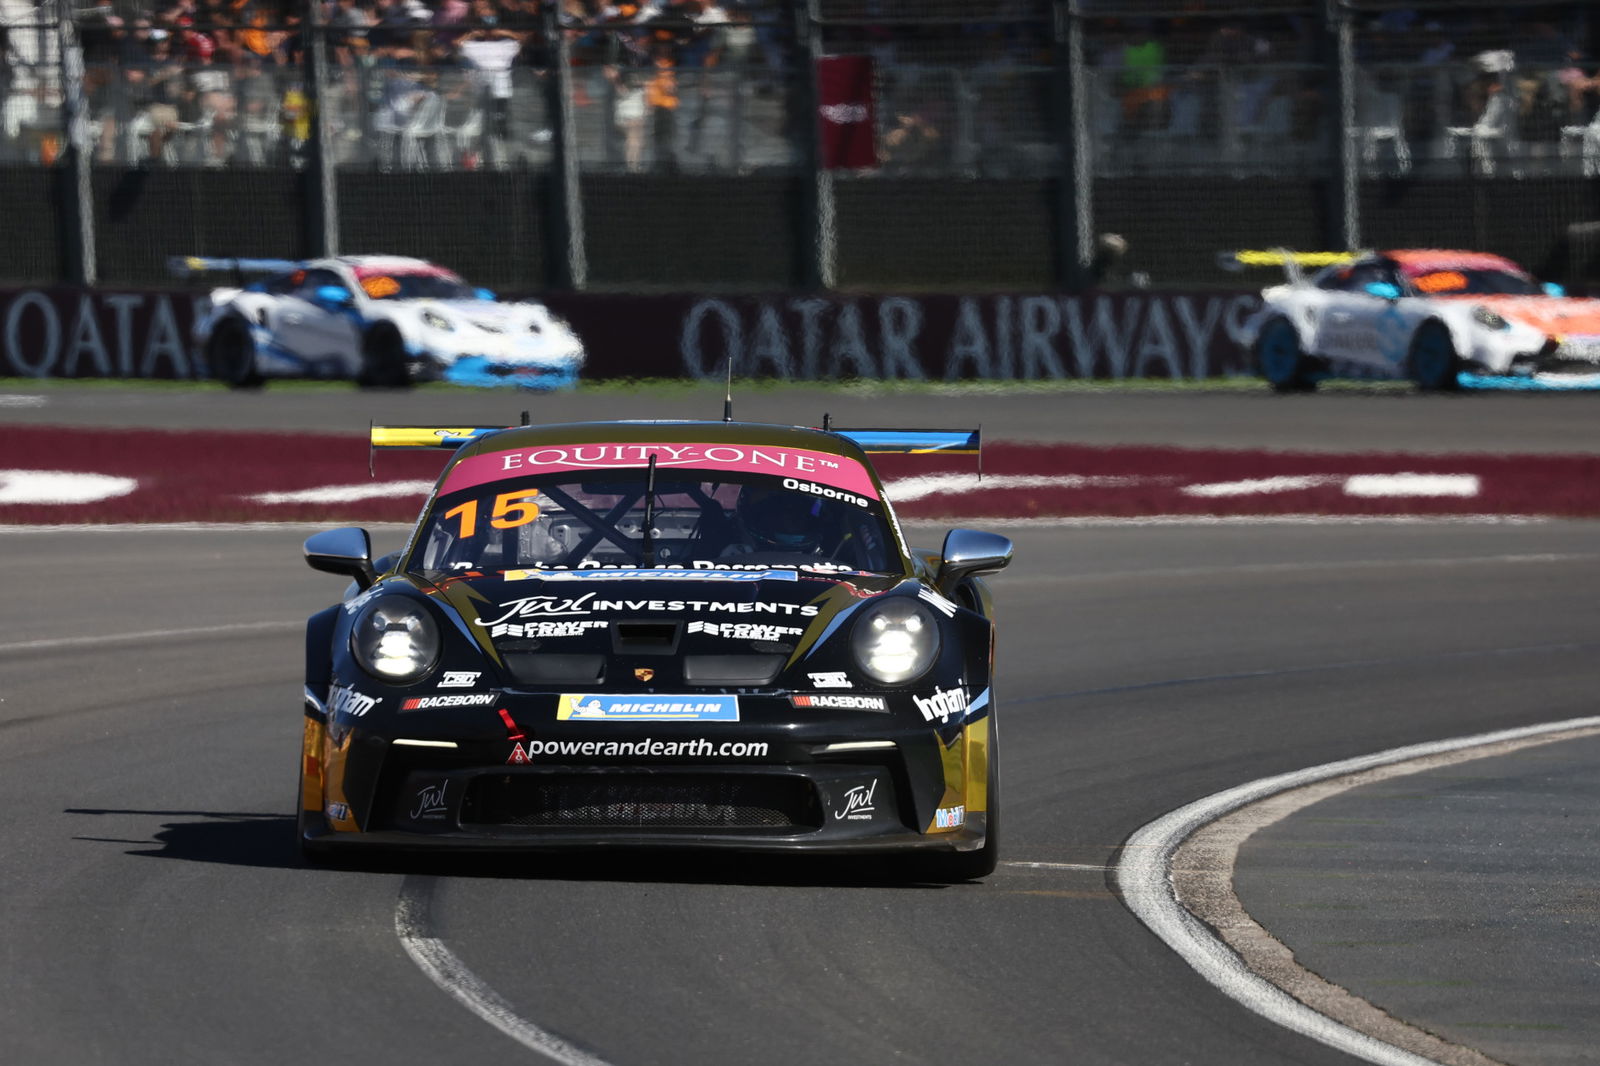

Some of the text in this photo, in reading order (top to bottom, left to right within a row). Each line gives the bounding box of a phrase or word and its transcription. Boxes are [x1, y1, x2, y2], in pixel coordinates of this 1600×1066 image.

[5, 291, 210, 377] QATA
[681, 297, 924, 378] QATAR
[782, 477, 869, 508] Osborne
[444, 489, 540, 539] 15
[592, 599, 819, 617] INVESTMENTS
[523, 620, 609, 632] POWER
[719, 623, 804, 636] POWER
[417, 694, 495, 709] RACEBORN
[608, 703, 722, 713] MICHELIN
[809, 695, 885, 710] RACEBORN
[527, 738, 769, 759] powerandearth.com
